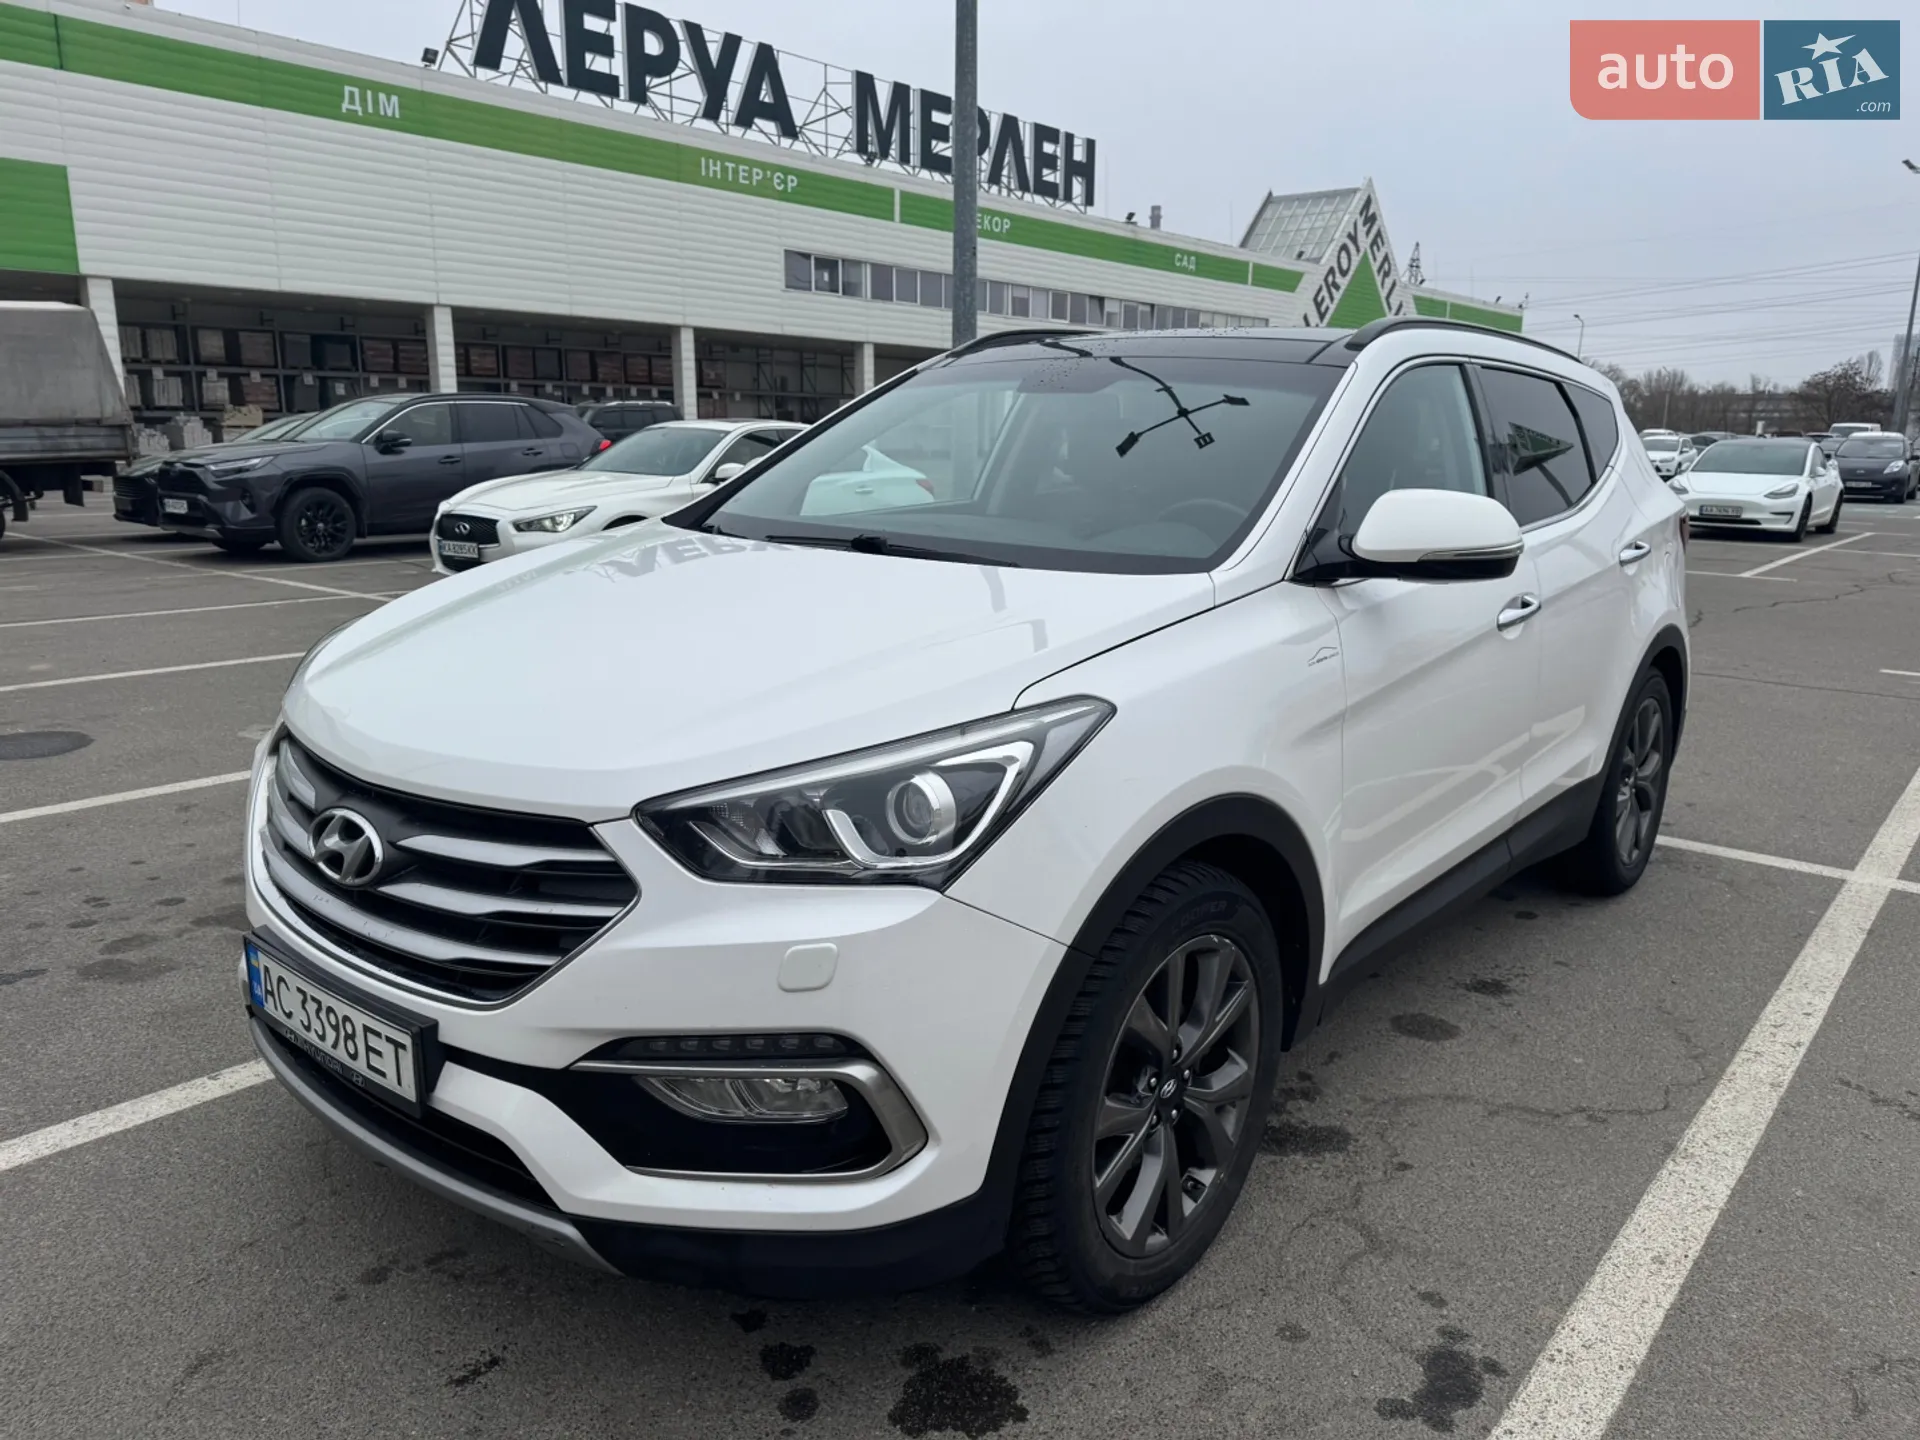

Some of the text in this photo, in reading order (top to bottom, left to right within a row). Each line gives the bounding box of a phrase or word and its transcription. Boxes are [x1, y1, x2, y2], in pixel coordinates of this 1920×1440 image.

[469, 0, 799, 139] ЛЕРУА
[341, 84, 400, 118] ДІМ
[976, 213, 1011, 233] ЕКОР
[1174, 253, 1196, 272] САД
[1359, 193, 1404, 316] MERLI
